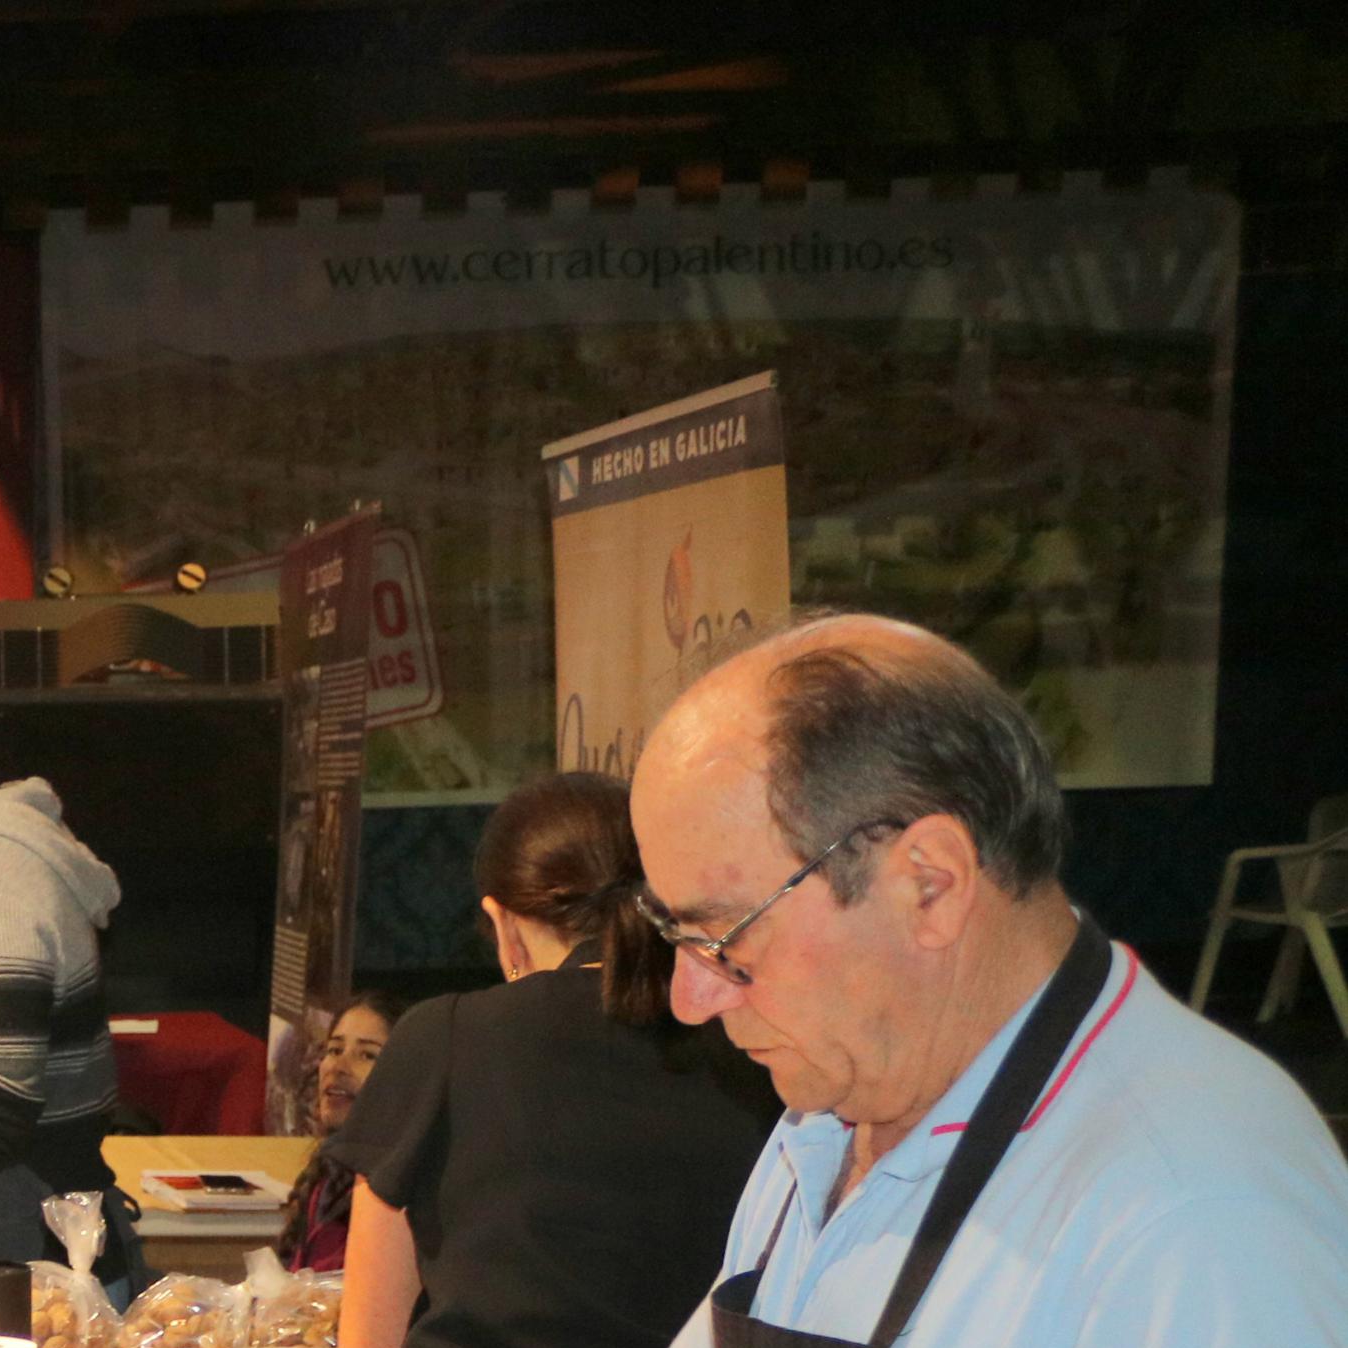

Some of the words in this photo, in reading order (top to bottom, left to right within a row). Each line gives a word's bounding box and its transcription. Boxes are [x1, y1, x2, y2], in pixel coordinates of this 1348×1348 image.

[322, 231, 954, 290] www.cerratopalentino.es
[591, 445, 645, 485] HECHO
[649, 439, 672, 470] EN
[675, 414, 748, 463] GALICIA
